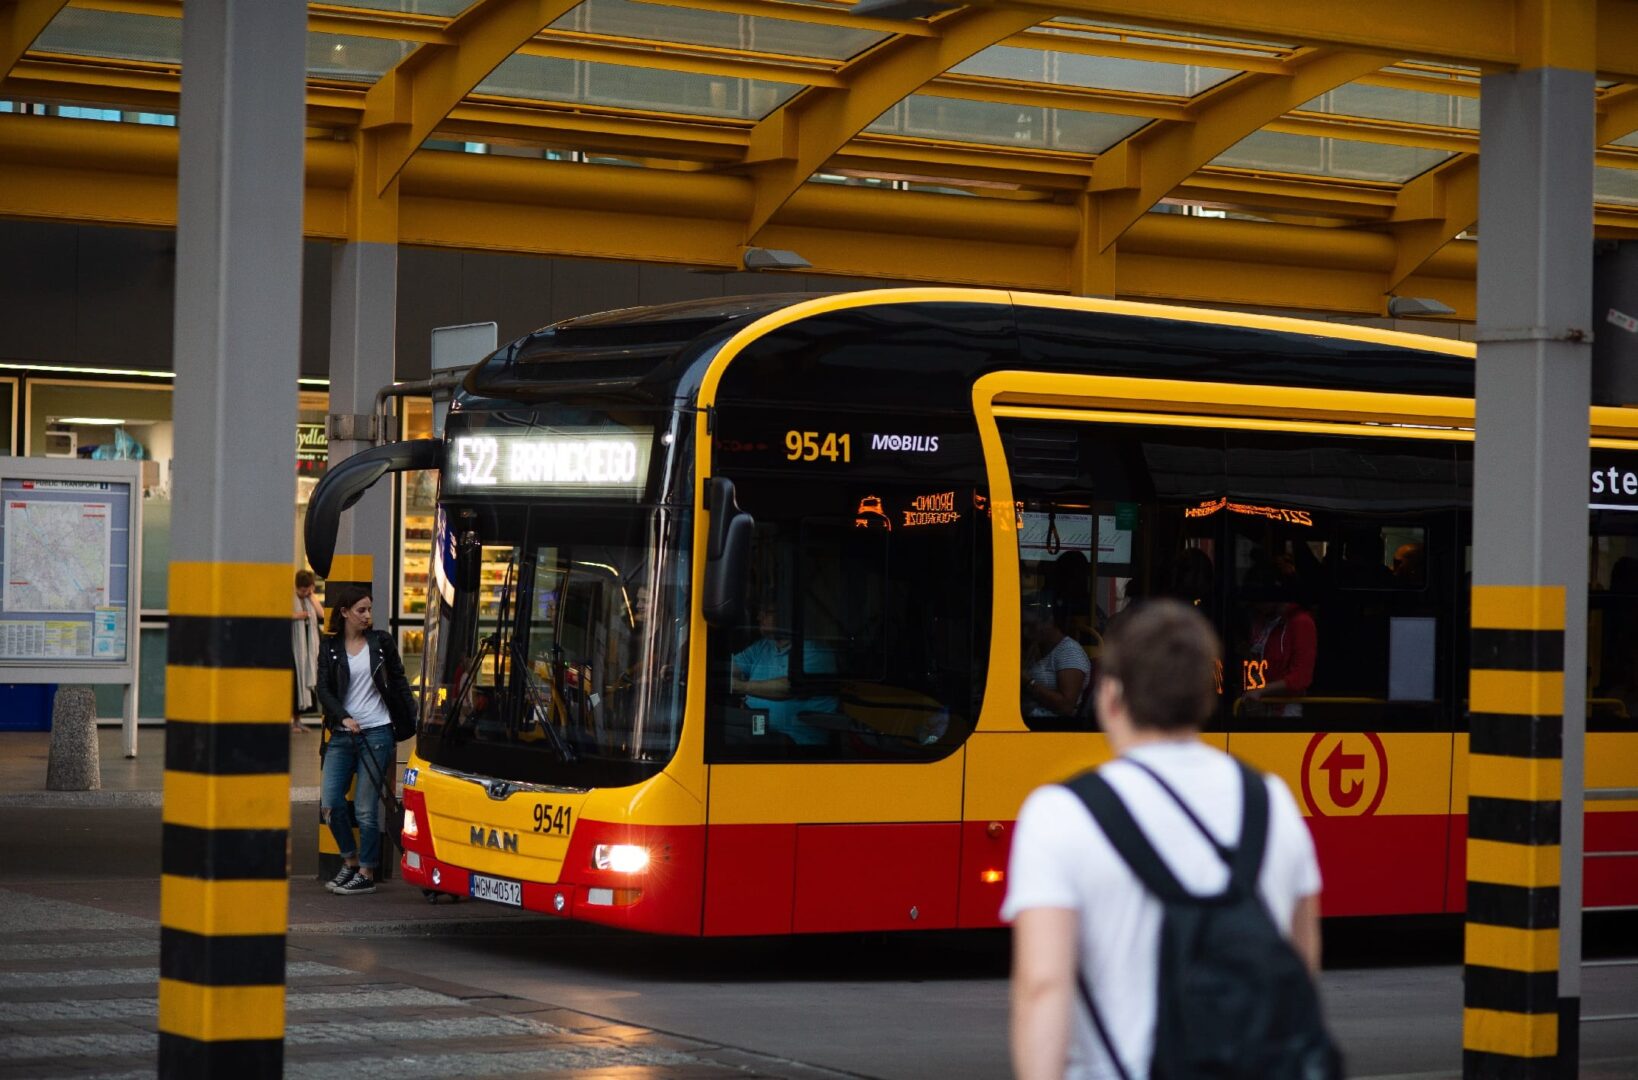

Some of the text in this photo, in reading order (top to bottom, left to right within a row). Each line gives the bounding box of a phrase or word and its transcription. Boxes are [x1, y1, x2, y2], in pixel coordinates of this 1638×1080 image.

[785, 430, 851, 463] 9541
[871, 434, 940, 452] MOBILIS
[457, 436, 498, 485] 522
[60, 481, 98, 489] TRANSPORT
[533, 803, 572, 835] 9541
[471, 826, 518, 851] MAN
[474, 876, 520, 903] WGM 40512
